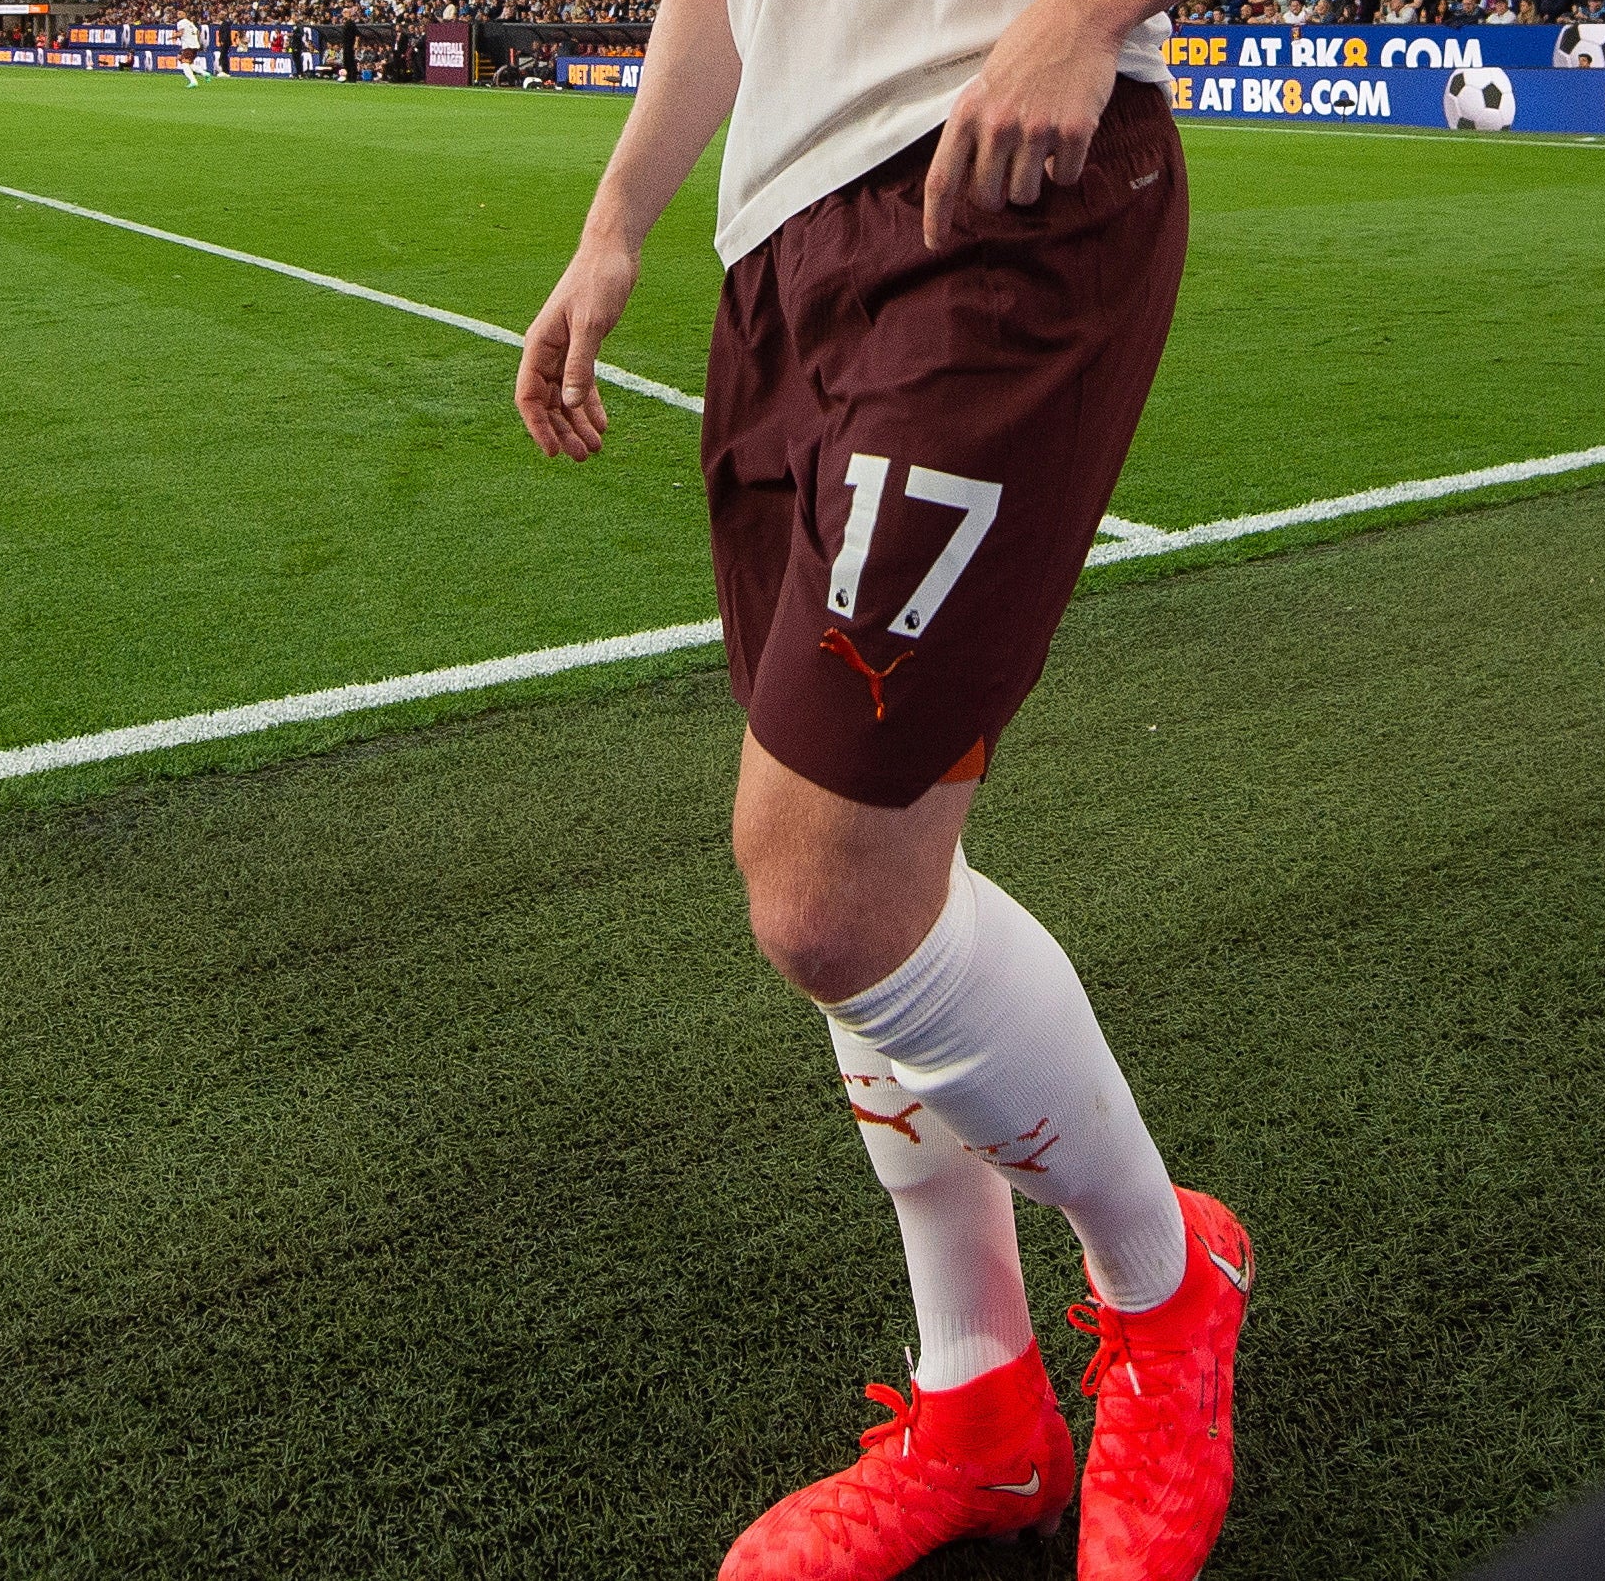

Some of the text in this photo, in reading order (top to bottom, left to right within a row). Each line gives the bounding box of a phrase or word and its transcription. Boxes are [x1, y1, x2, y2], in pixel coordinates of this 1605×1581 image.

[429, 42, 464, 55] FOOTBALL
[429, 55, 464, 68] MANAGER
[1239, 38, 1283, 67] AT
[568, 64, 638, 88] BET HERE AT
[1200, 80, 1236, 112] AT
[1242, 80, 1391, 117] BK8.COM
[827, 453, 1003, 638] 17
